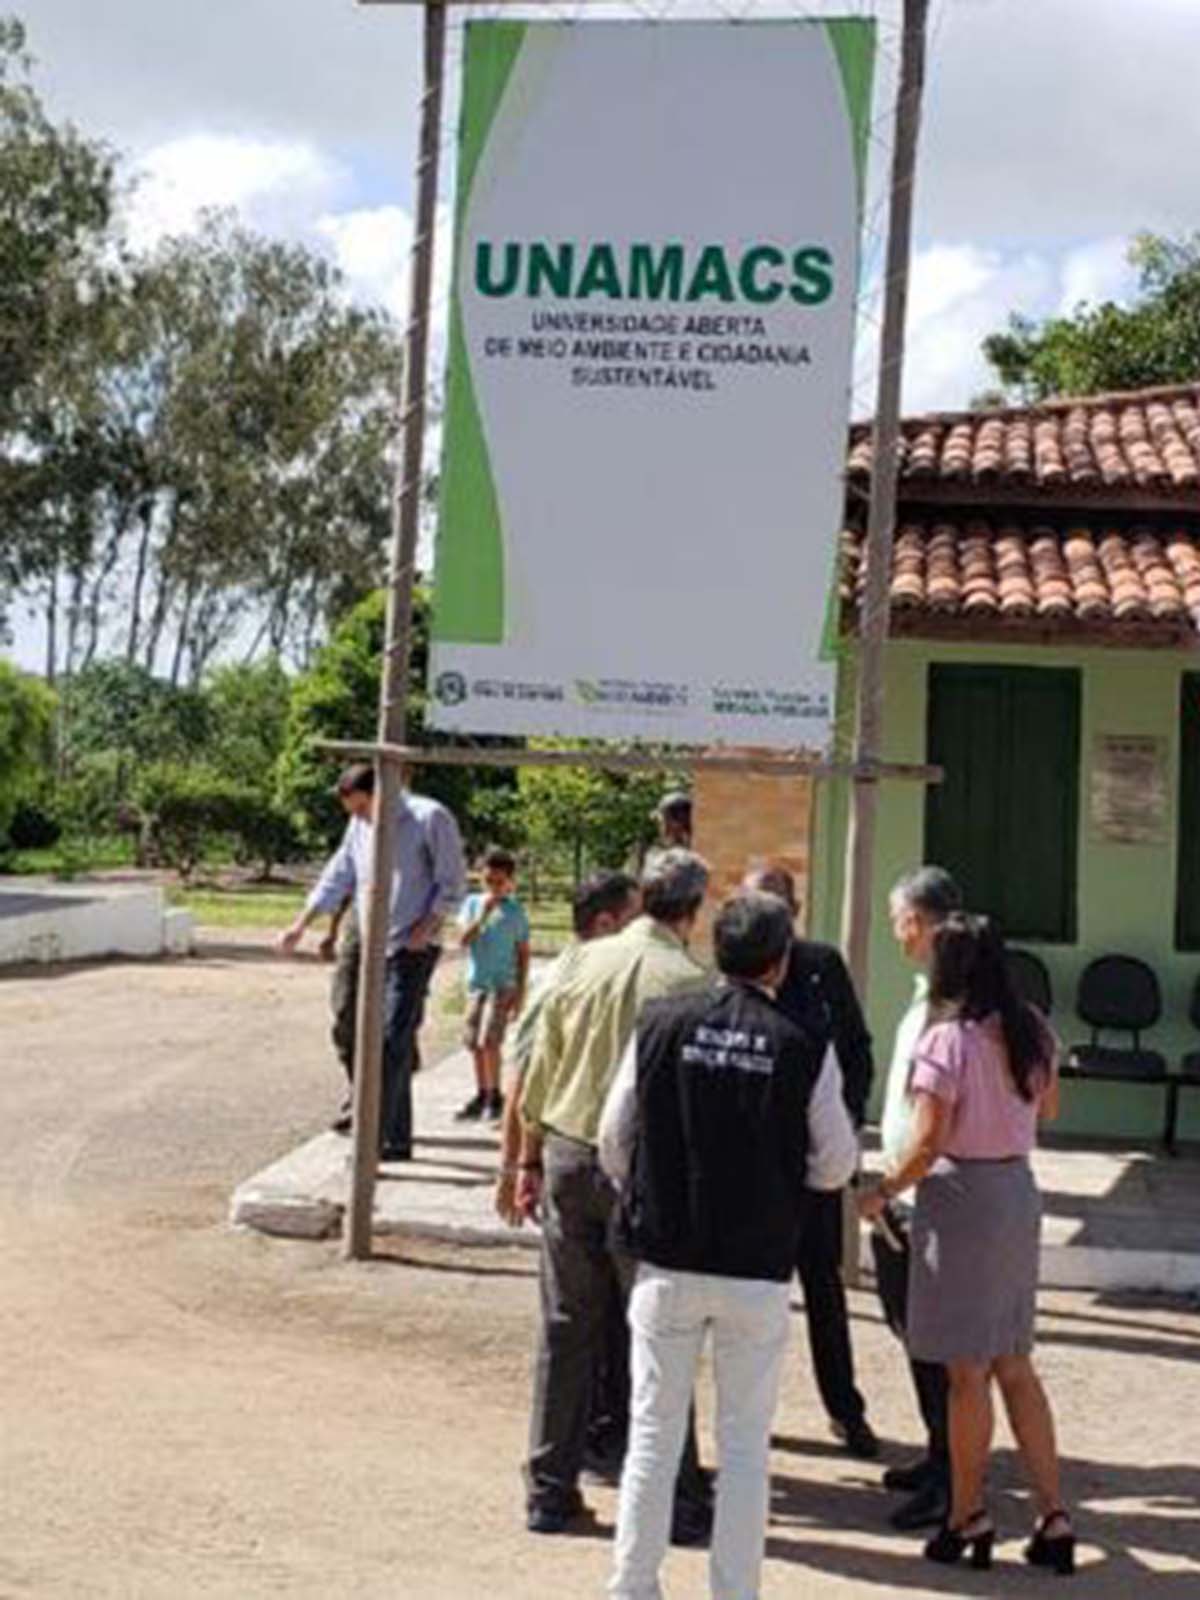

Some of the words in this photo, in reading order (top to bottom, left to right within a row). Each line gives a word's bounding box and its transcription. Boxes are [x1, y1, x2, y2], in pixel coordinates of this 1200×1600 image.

[474, 241, 834, 305] UNAMACS
[531, 311, 679, 336] UNIVERSIDADE
[684, 314, 766, 337] ABERTA
[485, 337, 514, 357] DE
[517, 338, 568, 358] MEIO
[572, 339, 672, 363] AMBIENTE
[679, 343, 690, 363] E
[696, 344, 812, 366] CIDADANIA
[571, 365, 717, 392] SUSTENTÁVEL
